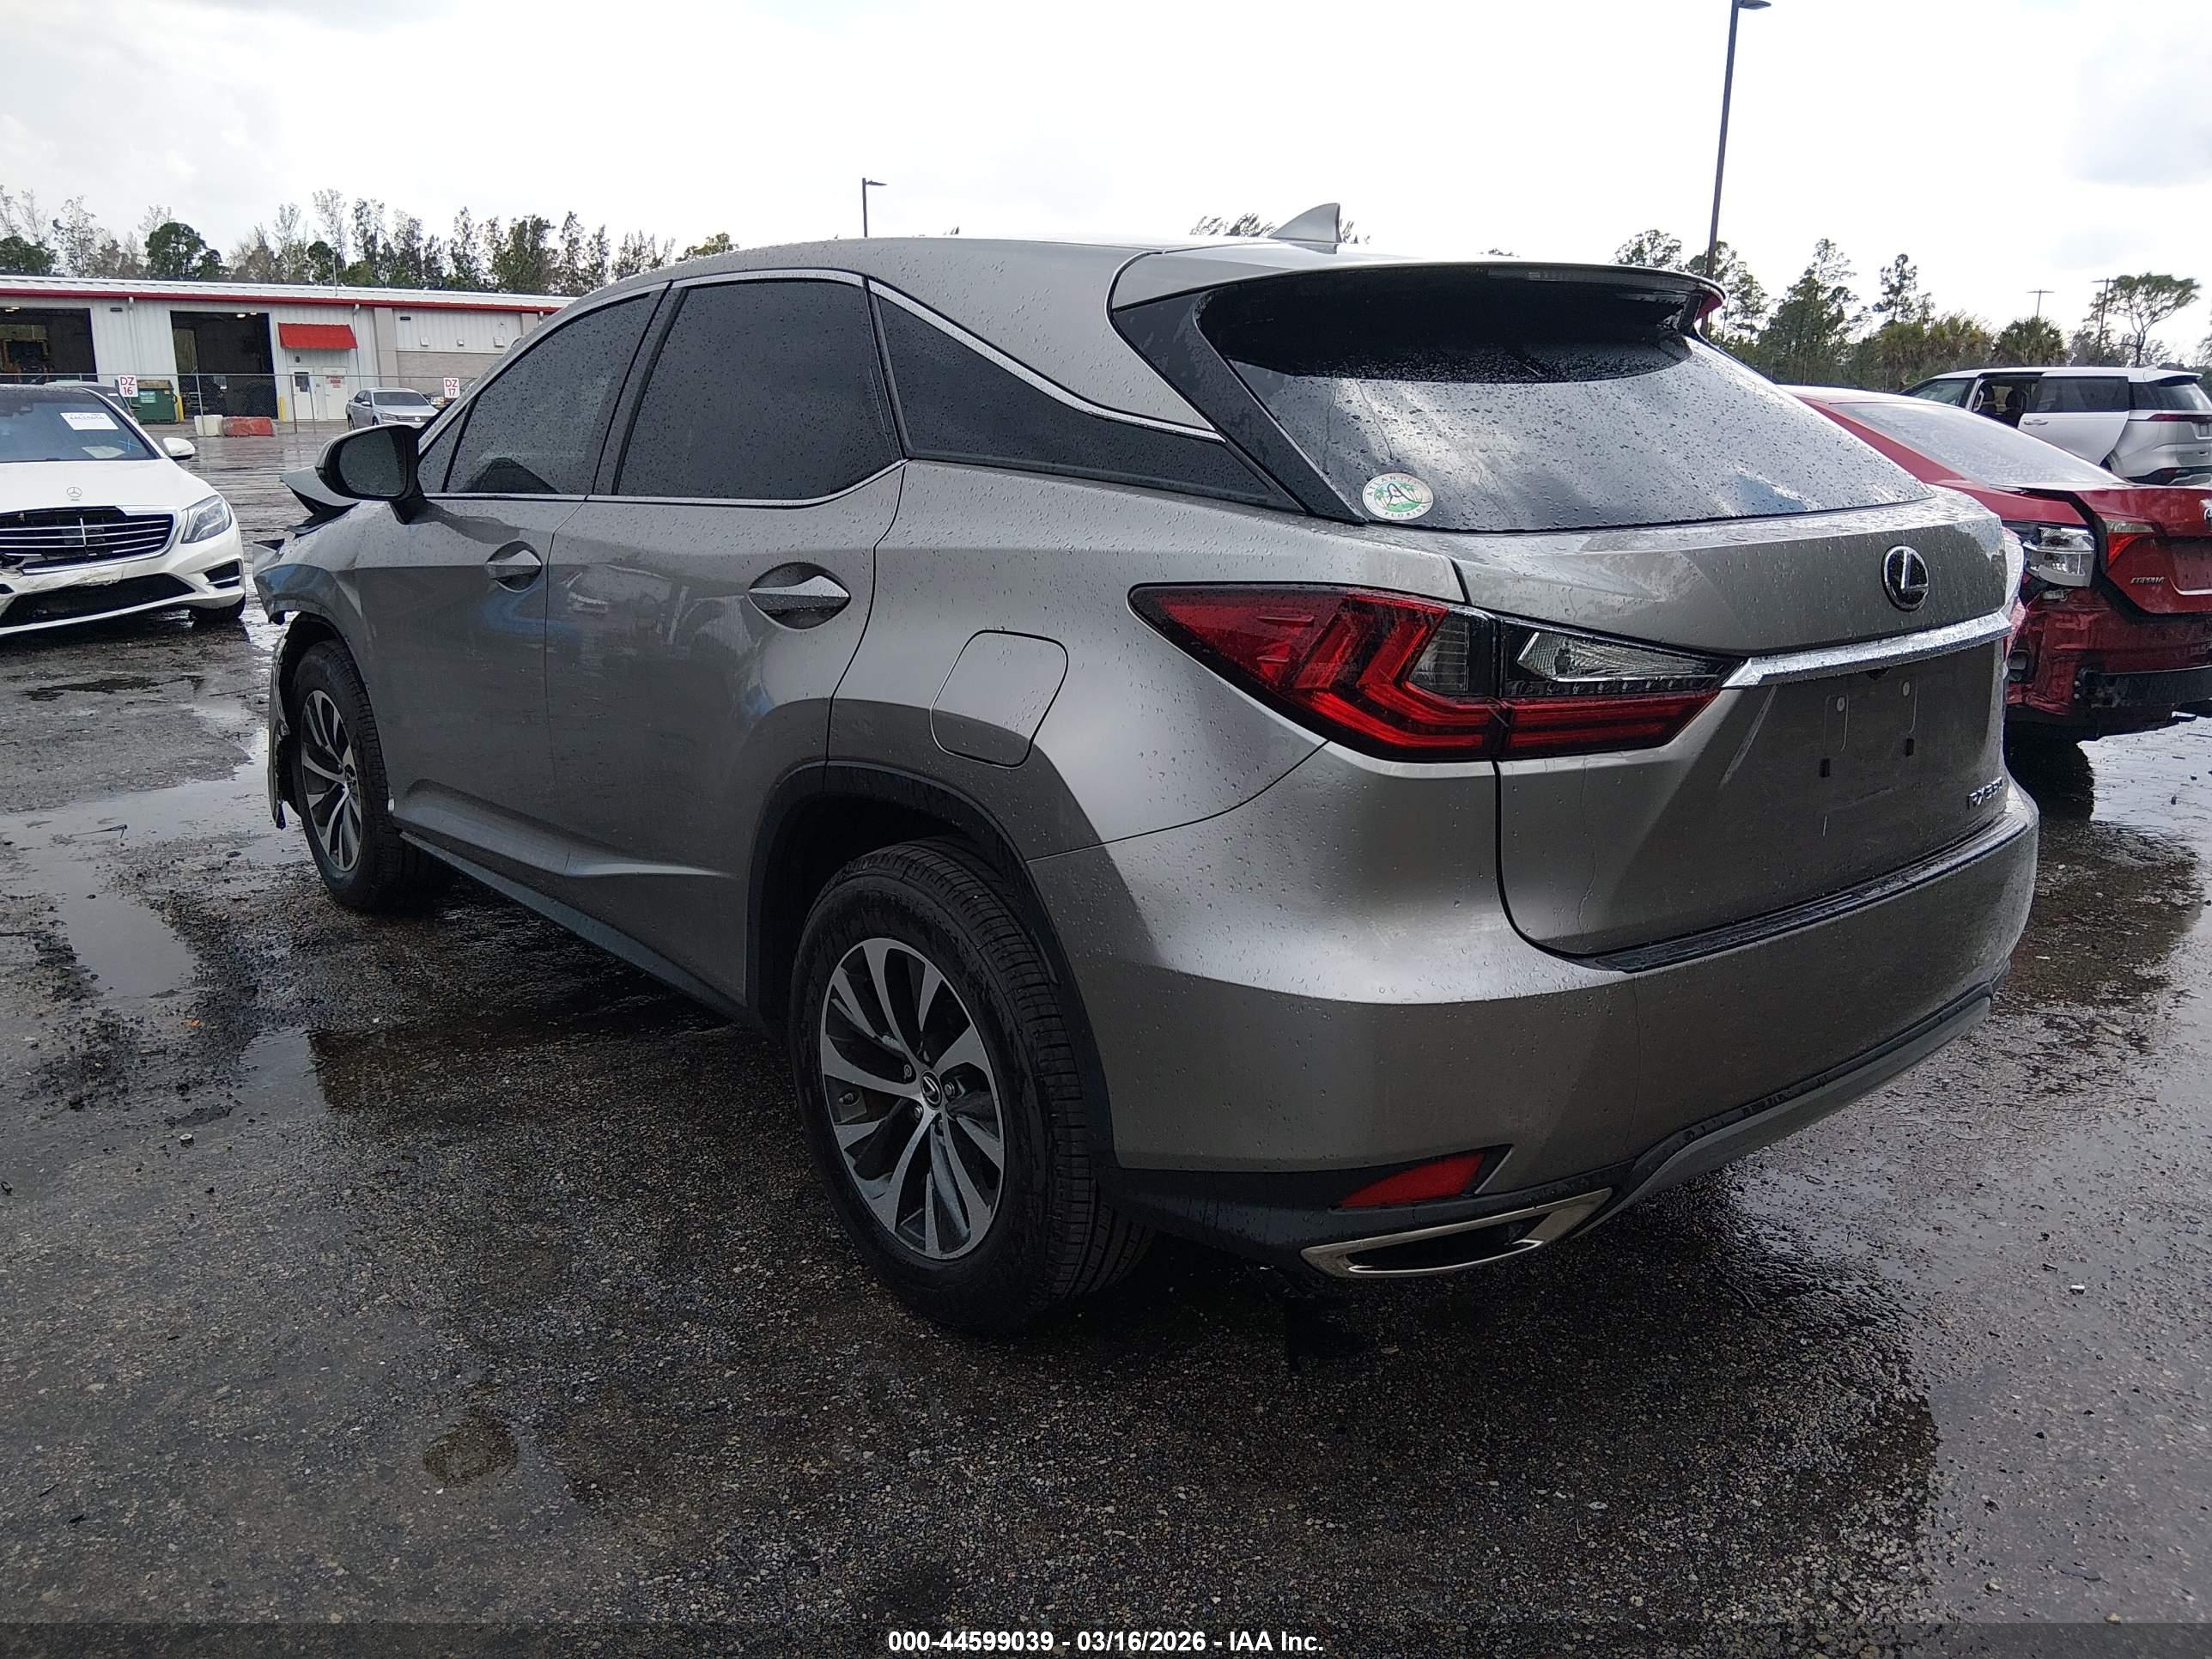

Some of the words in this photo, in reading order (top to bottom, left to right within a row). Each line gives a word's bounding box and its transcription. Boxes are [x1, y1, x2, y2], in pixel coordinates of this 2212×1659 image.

[120, 377, 136, 386] DZ
[445, 379, 458, 387] DZ
[123, 386, 133, 395] 16
[1384, 504, 1427, 518] FLORIDA
